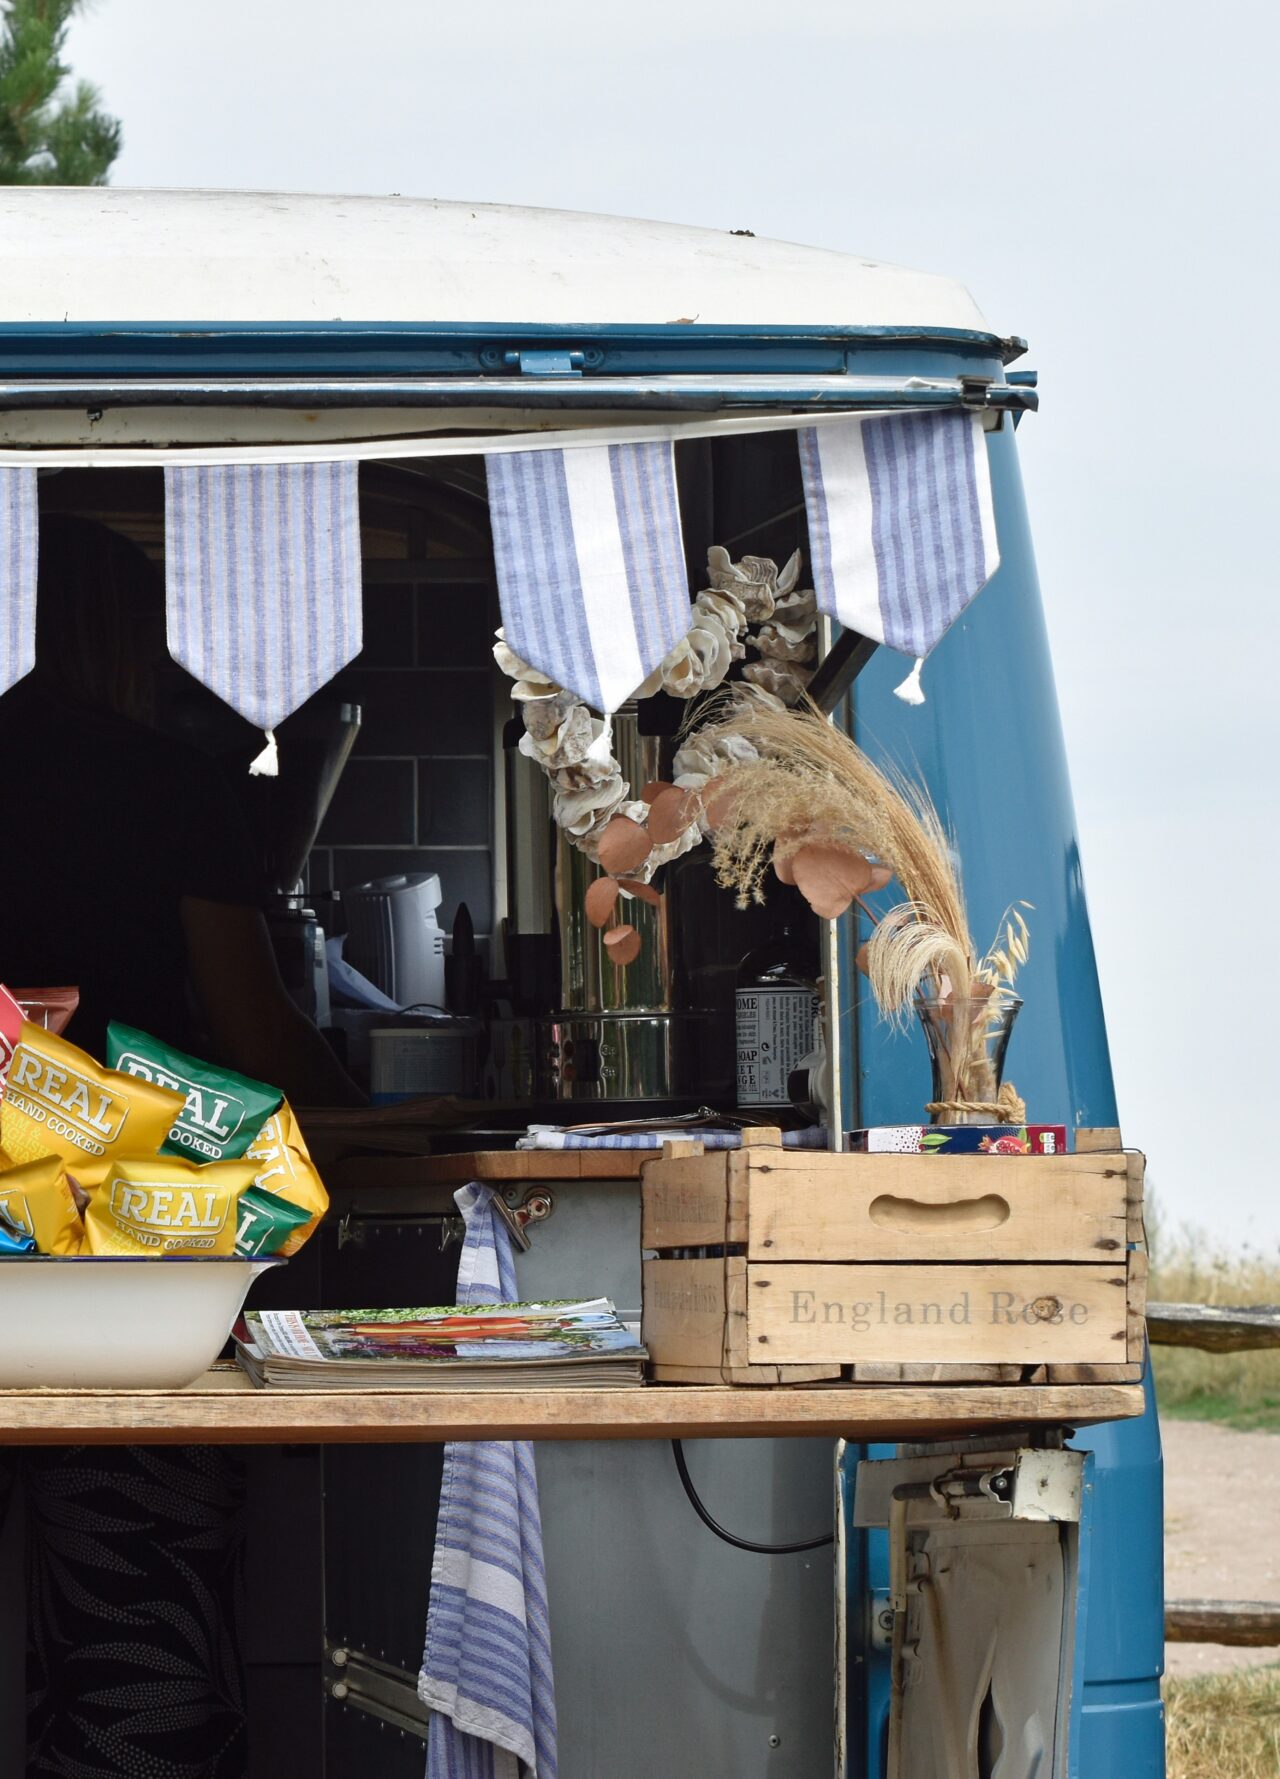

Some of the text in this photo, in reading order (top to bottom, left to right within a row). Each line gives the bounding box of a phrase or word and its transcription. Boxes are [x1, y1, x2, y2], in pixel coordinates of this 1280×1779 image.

[12, 1051, 113, 1135] REAL
[5, 1090, 46, 1123] HAND
[46, 1116, 105, 1156] COOKED
[169, 1128, 223, 1160] OOKED
[246, 1124, 286, 1190] EAL
[119, 1187, 221, 1228] REAL
[115, 1220, 161, 1248] HAND
[163, 1238, 216, 1251] COOKED
[788, 1290, 972, 1332] England
